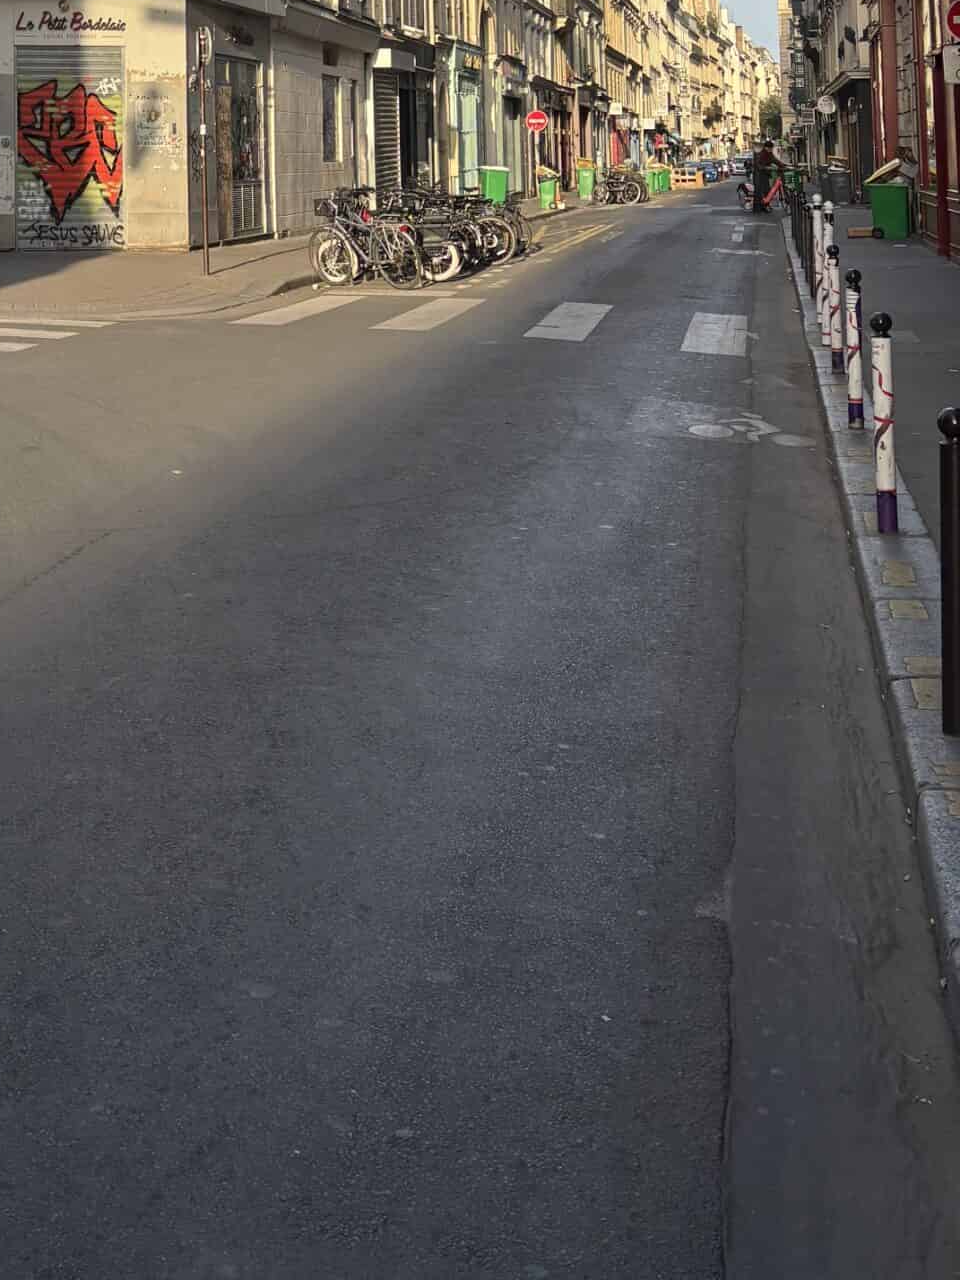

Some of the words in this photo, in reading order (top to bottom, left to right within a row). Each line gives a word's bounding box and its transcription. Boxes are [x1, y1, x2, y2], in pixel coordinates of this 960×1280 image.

[15, 11, 34, 31] Le
[38, 10, 69, 31] Petit
[23, 220, 78, 244] JESUS
[81, 223, 125, 245] SAUVE
